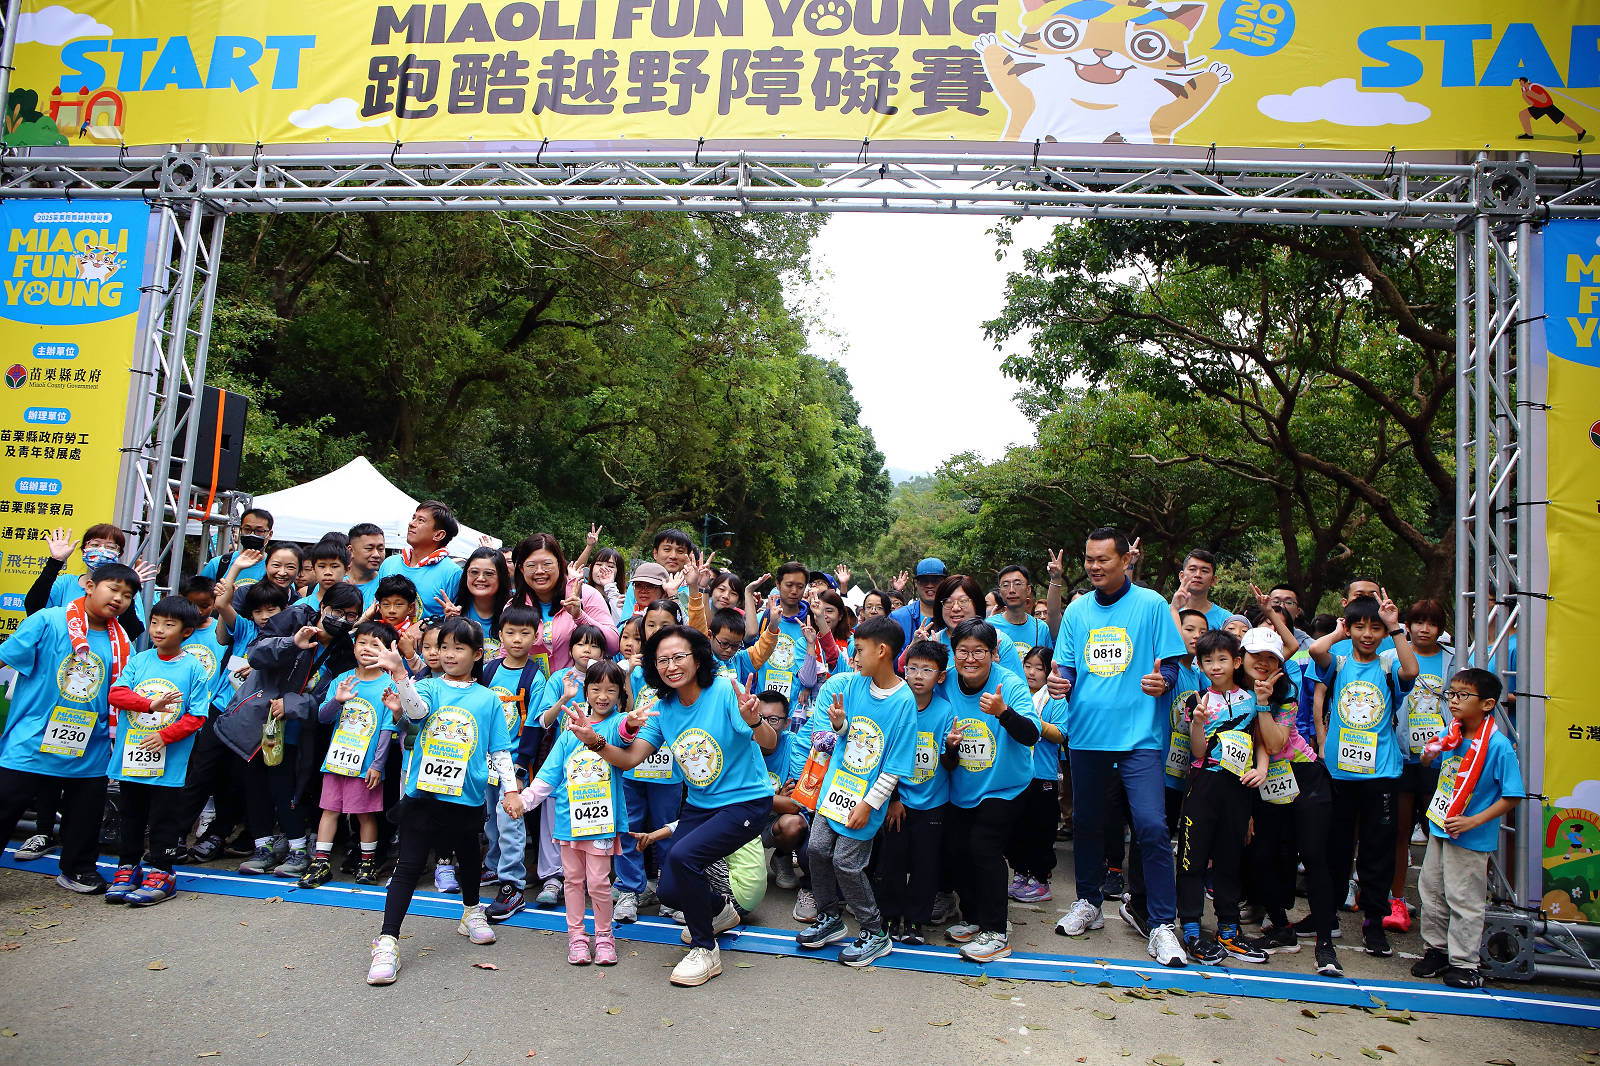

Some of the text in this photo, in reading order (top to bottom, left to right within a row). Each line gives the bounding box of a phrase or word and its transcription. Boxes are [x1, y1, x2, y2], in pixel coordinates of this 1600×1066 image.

[1236, 0, 1286, 25] 20
[371, 0, 999, 45] MIAOLI FUN YOUNG
[1229, 18, 1278, 47] 25
[60, 34, 317, 94] START
[361, 46, 994, 119] 跑酷越野障礙賽
[8, 228, 129, 252] MIAOLI
[12, 255, 77, 278] FUN
[4, 280, 124, 307] YOUNG
[36, 346, 76, 357] 主辦單位
[30, 368, 102, 383] 苗栗縣政府
[27, 410, 68, 422] 辦理單位
[1, 429, 89, 444] 苗栗縣政府勞工
[5, 445, 81, 461] 及青年發展處
[19, 480, 58, 492] 協辦單位
[0, 501, 74, 516] 苗栗縣警察局
[2, 526, 64, 541] 通霄鎮公
[1093, 647, 1122, 659] 0818
[51, 728, 86, 742] 1230
[429, 743, 459, 752] MIAOLI
[959, 743, 986, 755] 0817
[1225, 744, 1247, 763] 1246
[1342, 747, 1372, 761] 0219
[128, 750, 161, 763] 1239
[332, 749, 360, 765] 1110
[642, 754, 669, 765] 039
[425, 763, 463, 779] 0427
[572, 787, 601, 796] MIAOLI
[1263, 778, 1293, 795] 1247
[575, 805, 609, 820] 0423
